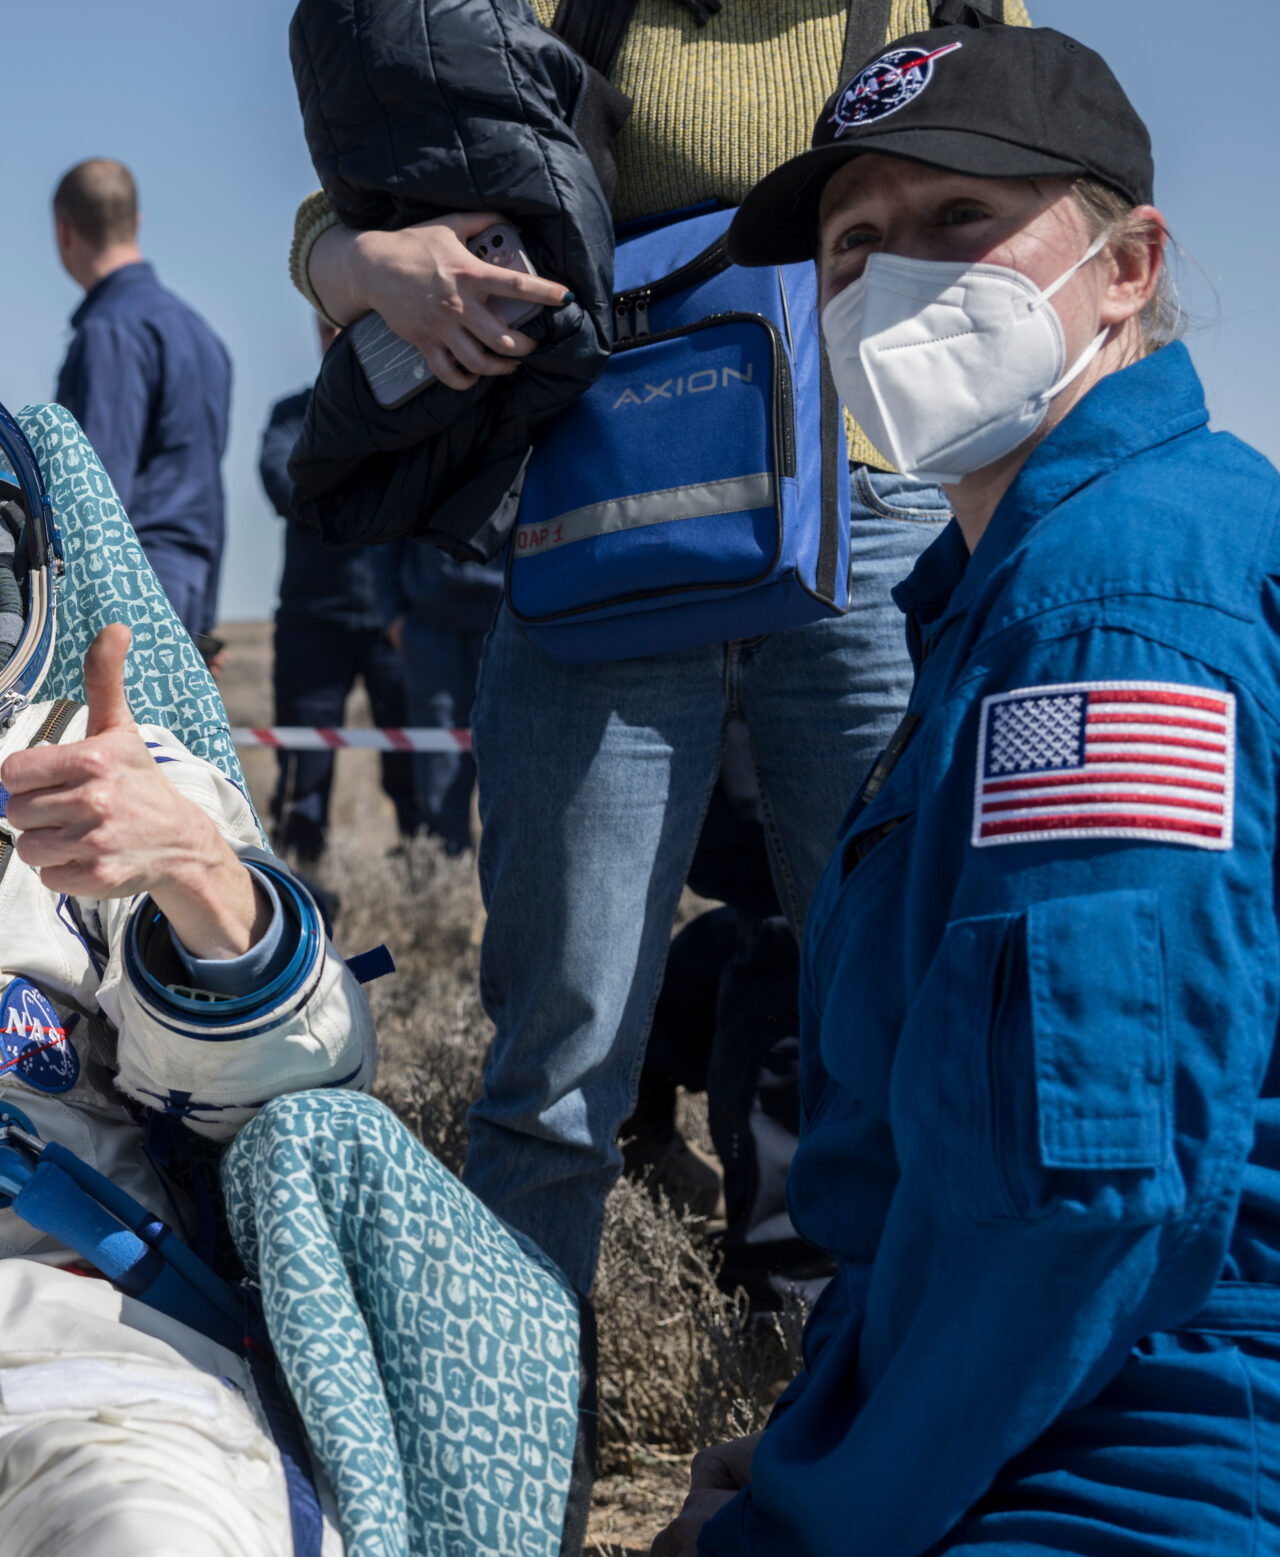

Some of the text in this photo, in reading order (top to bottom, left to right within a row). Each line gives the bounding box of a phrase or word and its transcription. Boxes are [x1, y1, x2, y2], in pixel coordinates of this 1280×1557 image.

[841, 66, 924, 107] NASA
[613, 363, 753, 410] AXION
[552, 523, 563, 544] 1
[5, 1006, 74, 1061] NASA
